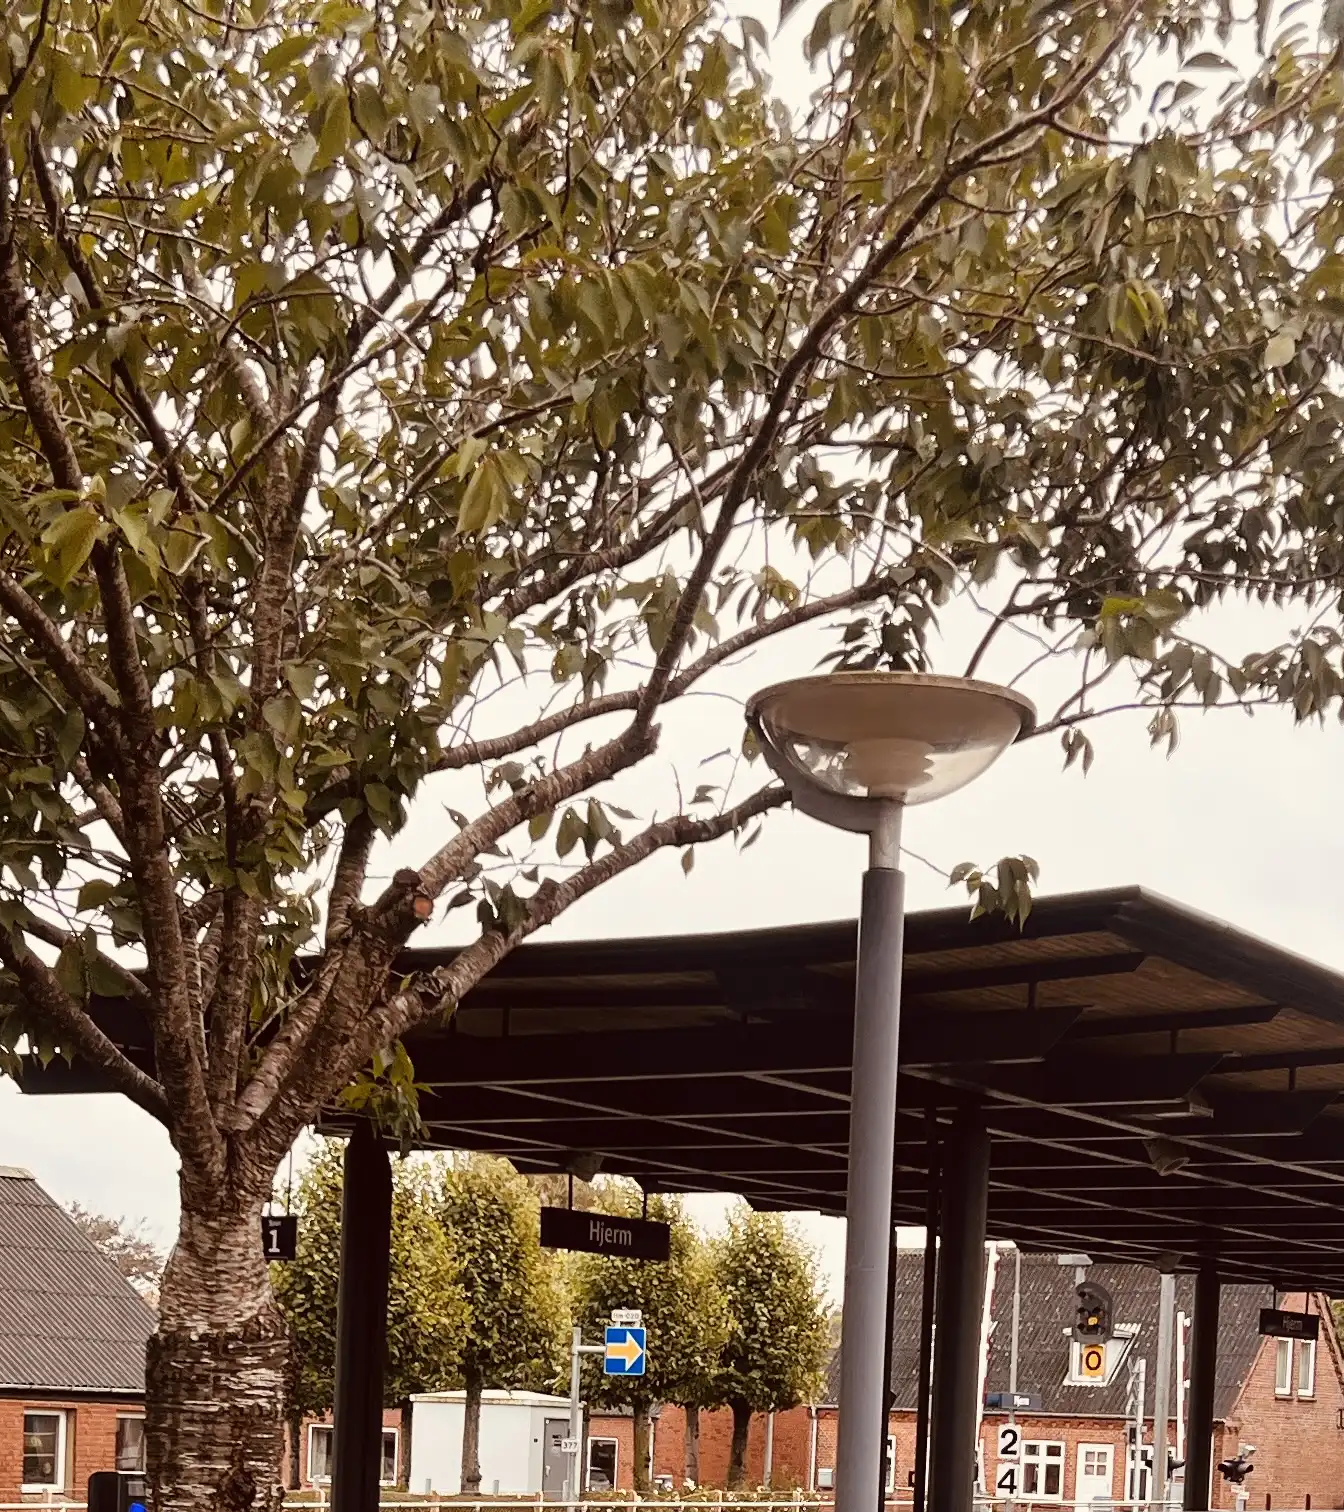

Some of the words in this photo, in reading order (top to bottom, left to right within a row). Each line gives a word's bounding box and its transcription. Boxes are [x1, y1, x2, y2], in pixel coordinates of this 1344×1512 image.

[268, 1229, 281, 1253] 1
[589, 1219, 632, 1247] Hjerm
[563, 1441, 578, 1449] 377
[1000, 1428, 1018, 1456] 2
[997, 1468, 1017, 1495] 4
